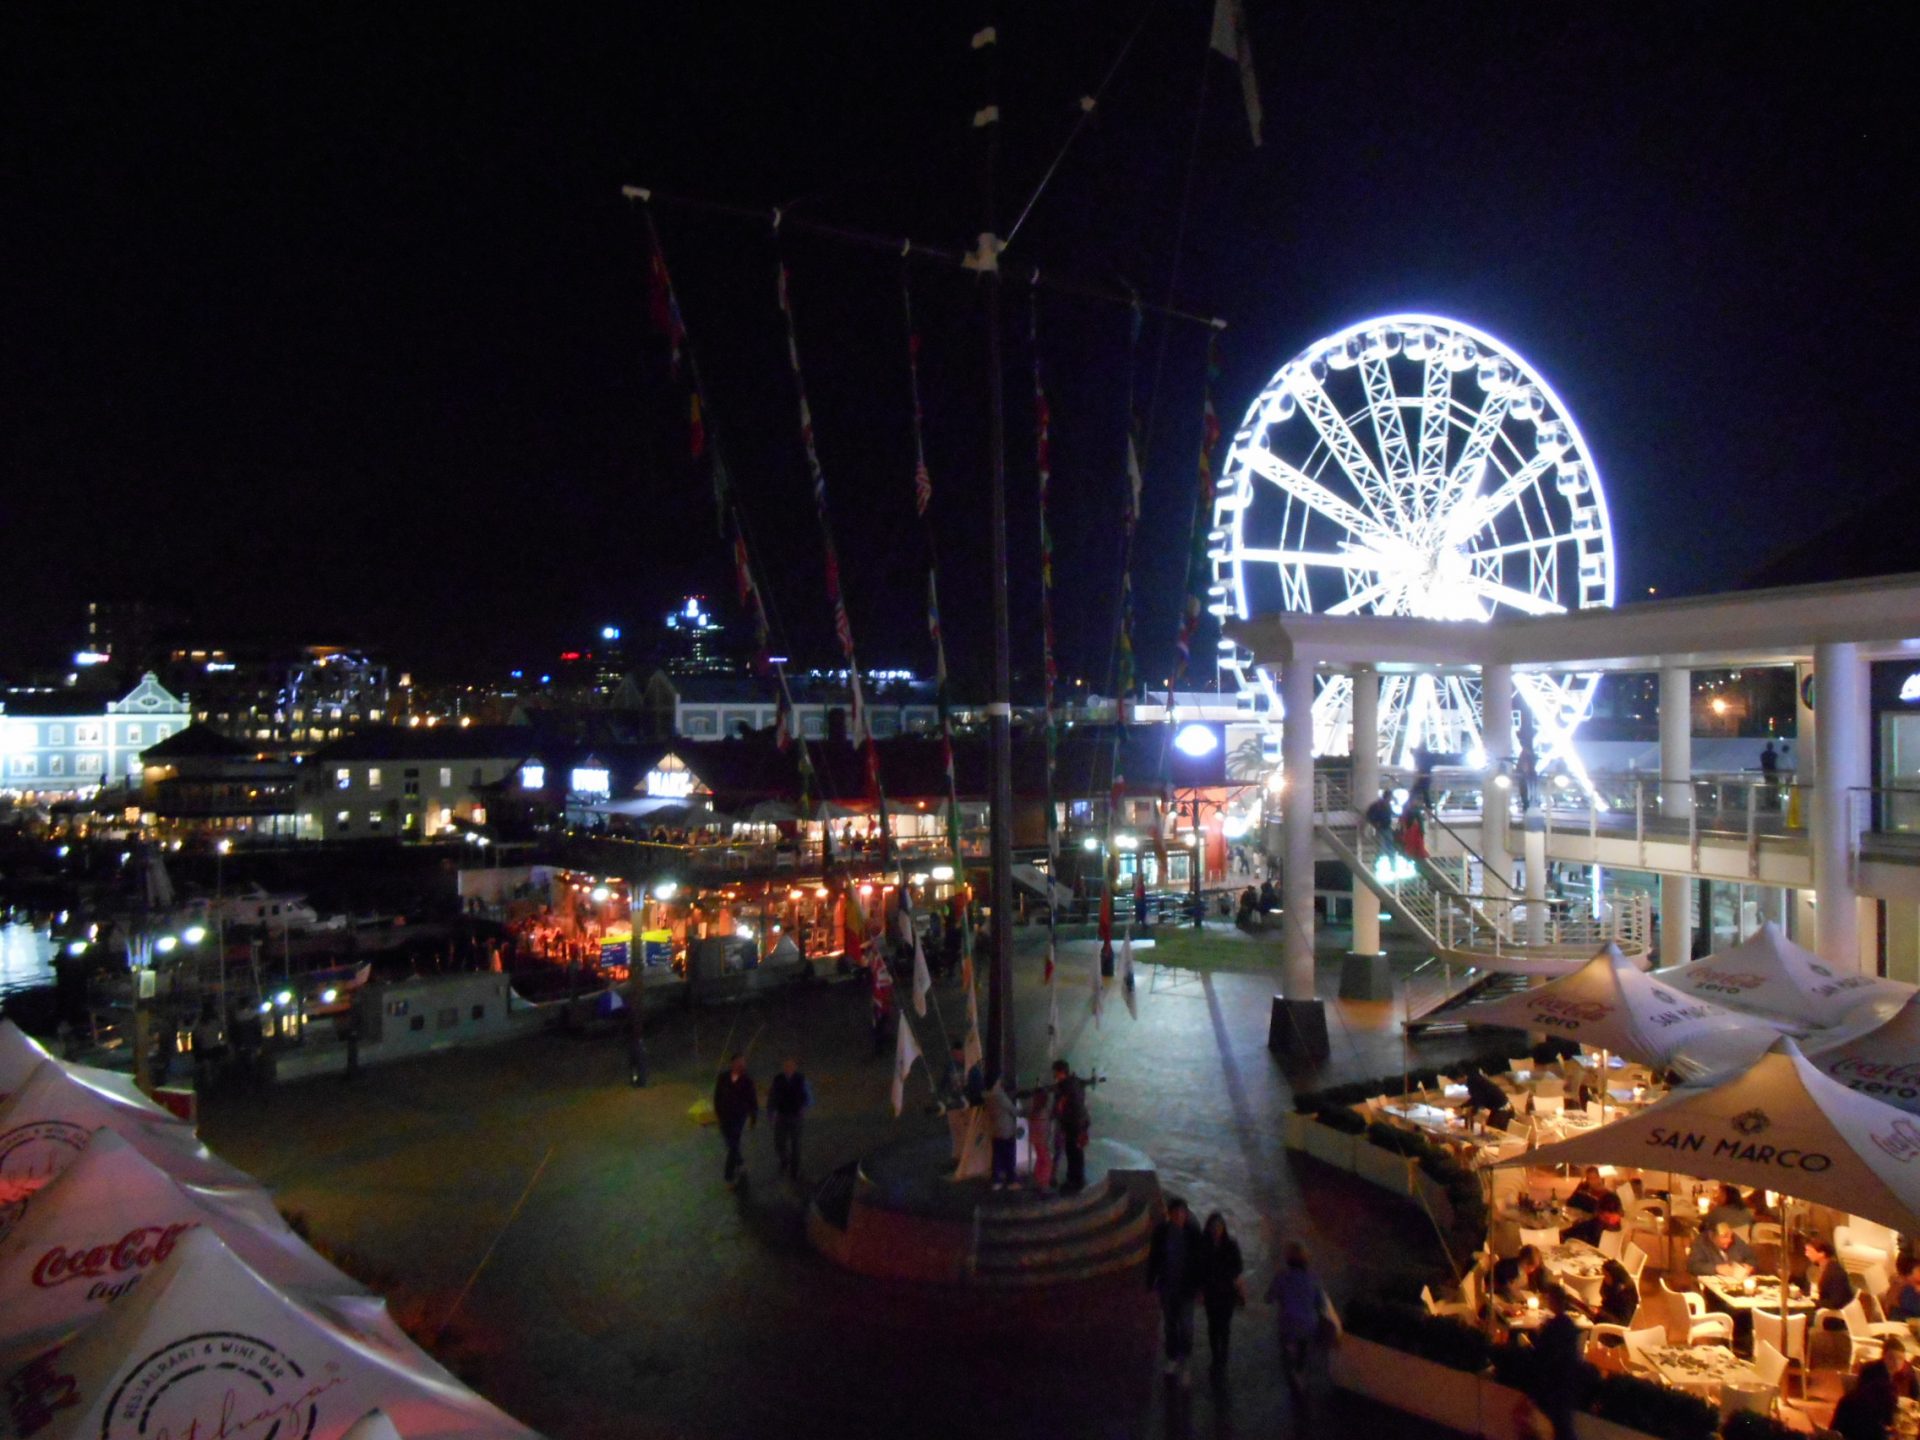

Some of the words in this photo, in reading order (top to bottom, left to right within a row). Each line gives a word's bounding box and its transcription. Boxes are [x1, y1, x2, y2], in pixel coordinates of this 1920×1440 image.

[1646, 1128, 1704, 1153] SAN
[1713, 1139, 1832, 1173] MARCO
[32, 1222, 202, 1288] Coca-Col
[123, 1348, 197, 1420] RESTAURANT
[203, 1343, 213, 1355] &
[220, 1342, 257, 1360] WINE
[258, 1355, 285, 1380] BAR
